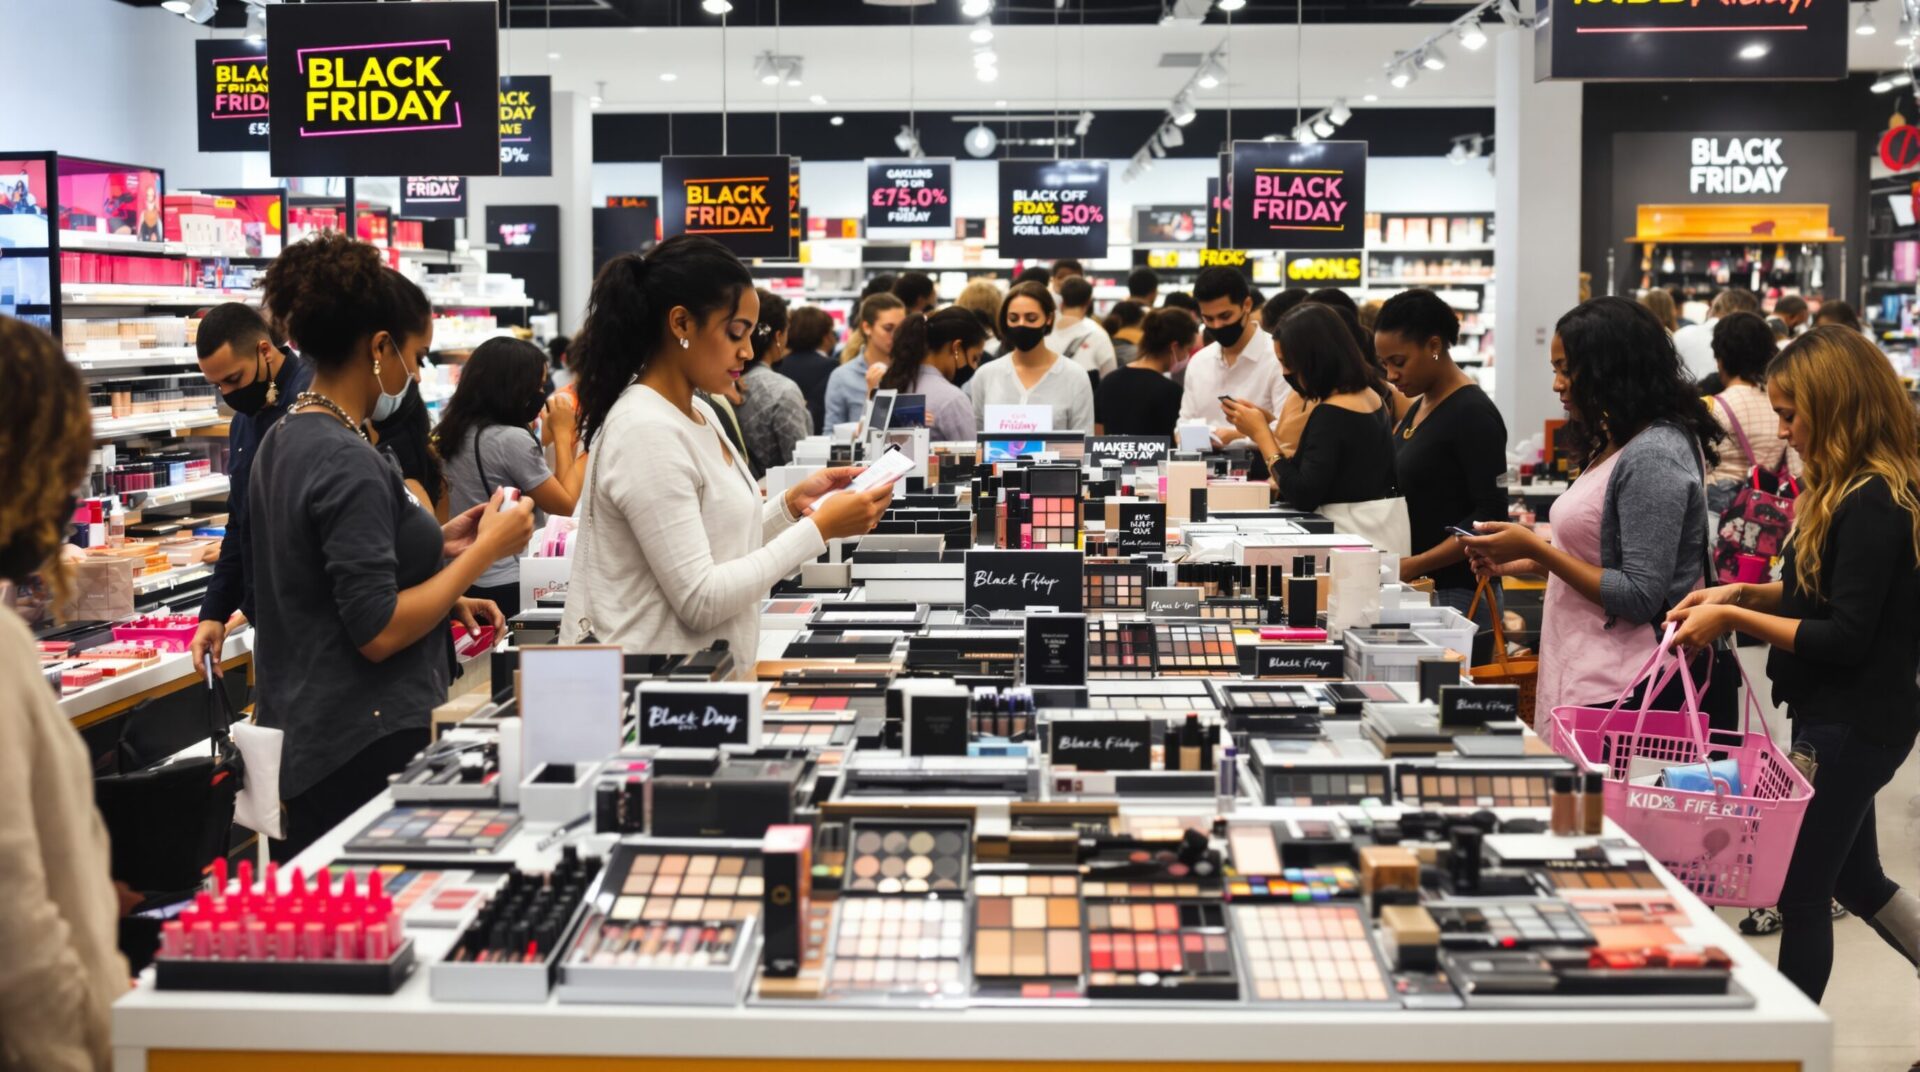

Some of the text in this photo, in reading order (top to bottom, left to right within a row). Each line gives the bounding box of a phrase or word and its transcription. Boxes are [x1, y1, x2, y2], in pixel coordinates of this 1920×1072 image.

[308, 56, 443, 88] BLACK
[215, 93, 269, 111] FRID
[306, 90, 451, 121] FRIDAY
[1691, 138, 1783, 165] BLACK
[1255, 175, 1342, 198] BLACK
[1690, 166, 1788, 193] FRIDAY
[407, 182, 459, 197] FRIDAY
[687, 185, 767, 204] BLACK
[872, 188, 948, 207] £75.0%
[1013, 190, 1088, 201] BLACK OFF
[685, 206, 772, 225] FRIDAY
[1061, 204, 1104, 224] 50%
[1253, 199, 1347, 222] FRIDAY
[1093, 442, 1165, 452] MAKEE NON
[973, 570, 1017, 588] Black
[648, 705, 699, 728] Black
[1629, 791, 1676, 810] KID%
